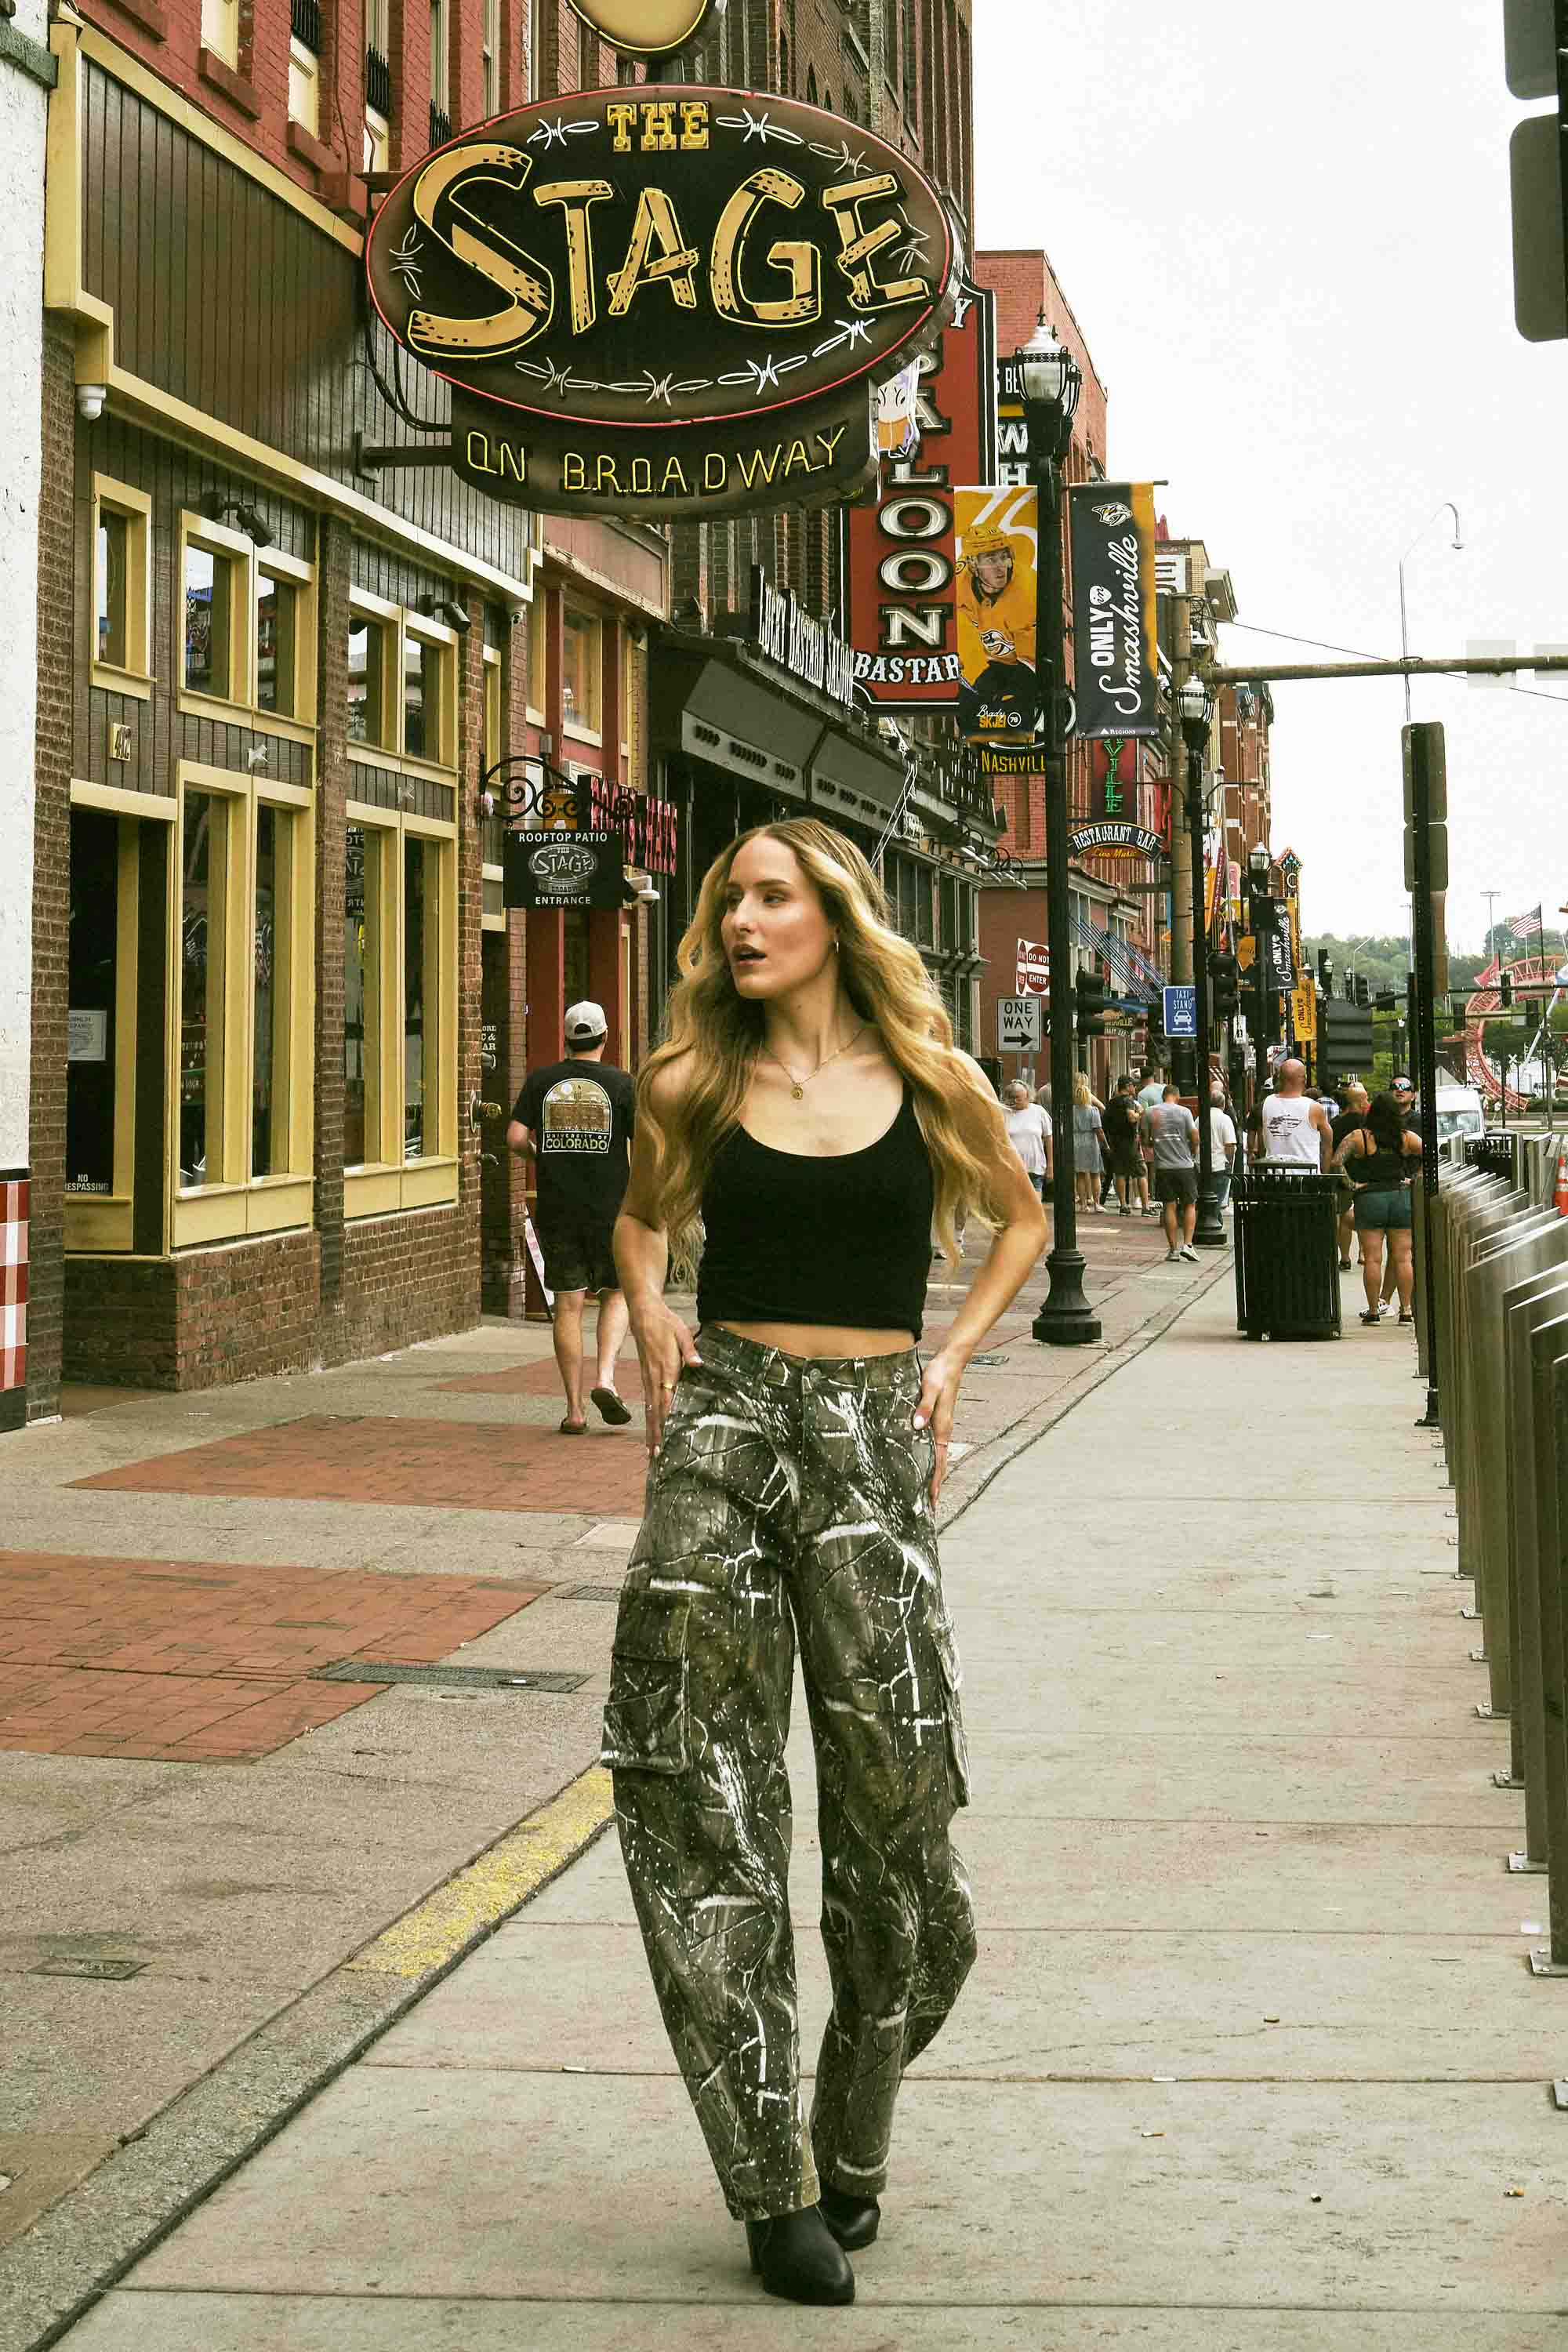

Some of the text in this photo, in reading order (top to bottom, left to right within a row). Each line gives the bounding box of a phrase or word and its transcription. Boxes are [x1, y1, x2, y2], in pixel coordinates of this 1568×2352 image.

[607, 102, 709, 151] THE
[407, 144, 934, 358] STAGE
[467, 426, 845, 493] ON BROADWAY
[1099, 534, 1142, 714] Smashville
[1090, 608, 1115, 666] ONLY
[976, 704, 1005, 720] Brady
[519, 833, 608, 843] ROOFTOP PATIO
[1073, 825, 1156, 851] RESTAURANT BAR
[533, 850, 593, 874] STAGE
[1029, 953, 1036, 962] DO
[1272, 942, 1282, 964] ONLY
[1029, 975, 1047, 985] ENTER
[1175, 989, 1189, 999] TAXI
[1004, 1001, 1033, 1014] ONE
[1004, 1017, 1033, 1029] WAY
[546, 1138, 608, 1150] COLORADO
[78, 1174, 89, 1182] NO
